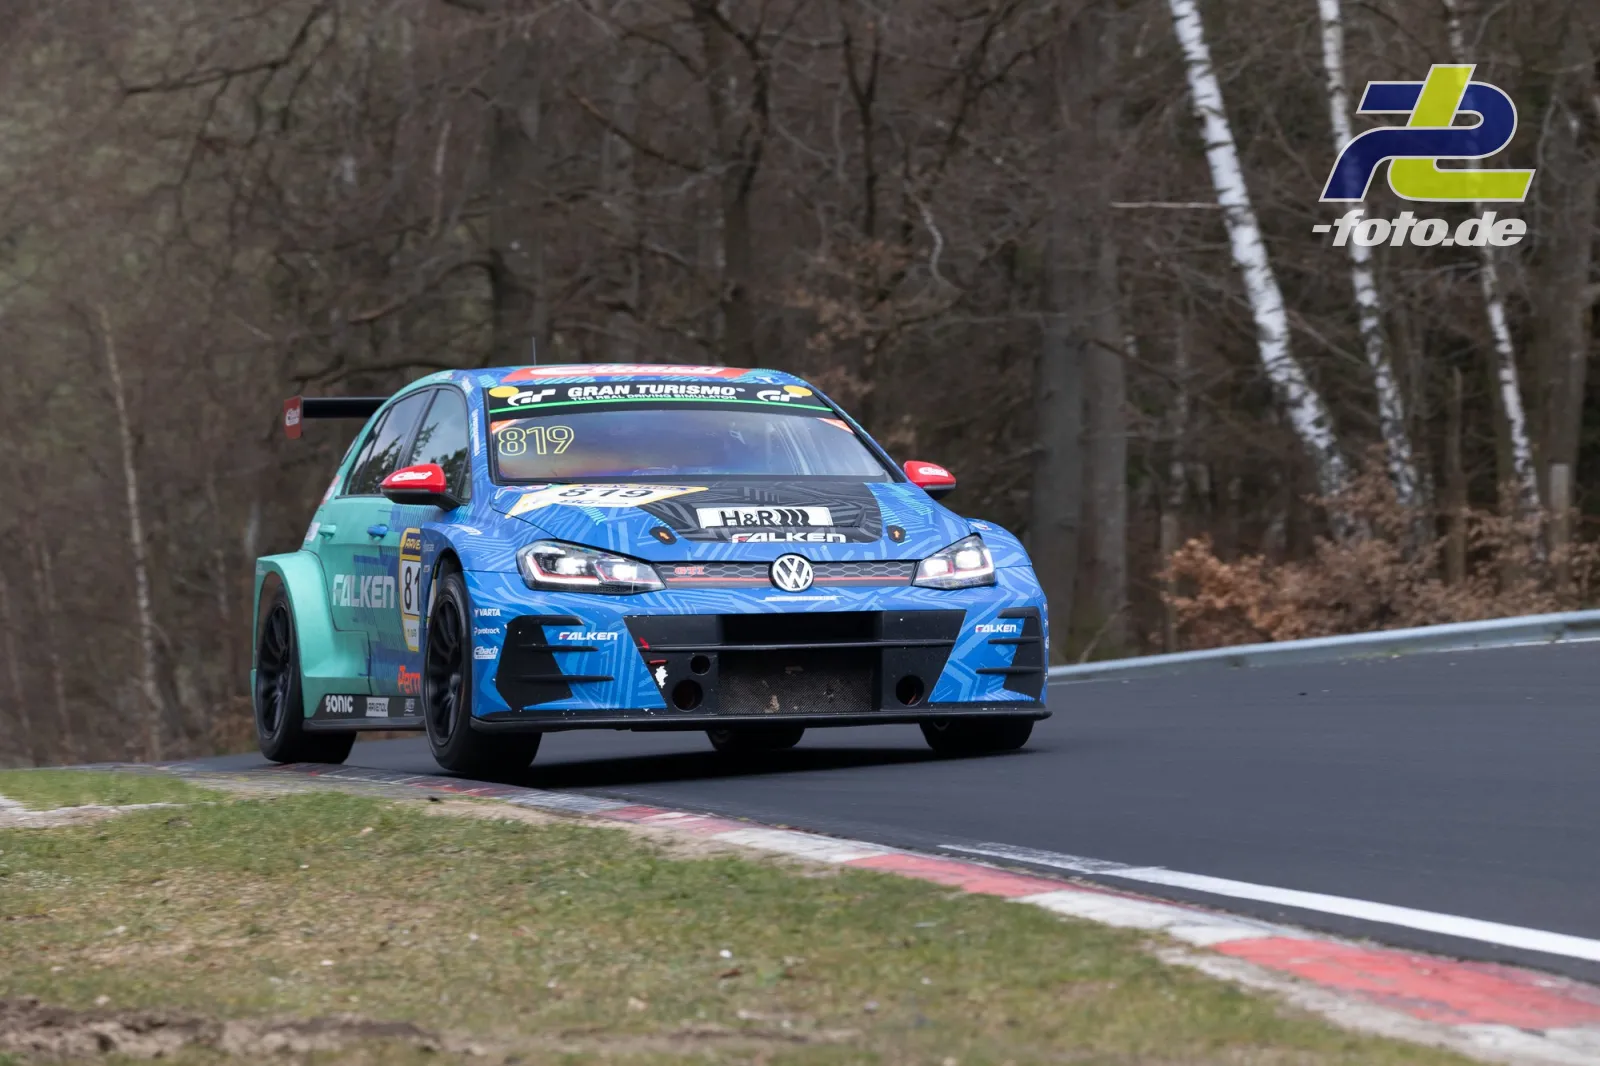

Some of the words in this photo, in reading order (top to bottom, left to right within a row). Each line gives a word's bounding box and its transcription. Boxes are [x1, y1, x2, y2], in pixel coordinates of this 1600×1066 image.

[567, 385, 631, 397] GRAN
[636, 384, 736, 396] TURISMO
[497, 424, 575, 457] 819
[558, 488, 654, 498] 819
[719, 508, 776, 527] H&R
[731, 532, 847, 544] FALKEN
[332, 573, 396, 609] FALKEN
[479, 608, 501, 617] VARTA
[975, 624, 1017, 633] FALKEN
[558, 631, 618, 641] FALKEN
